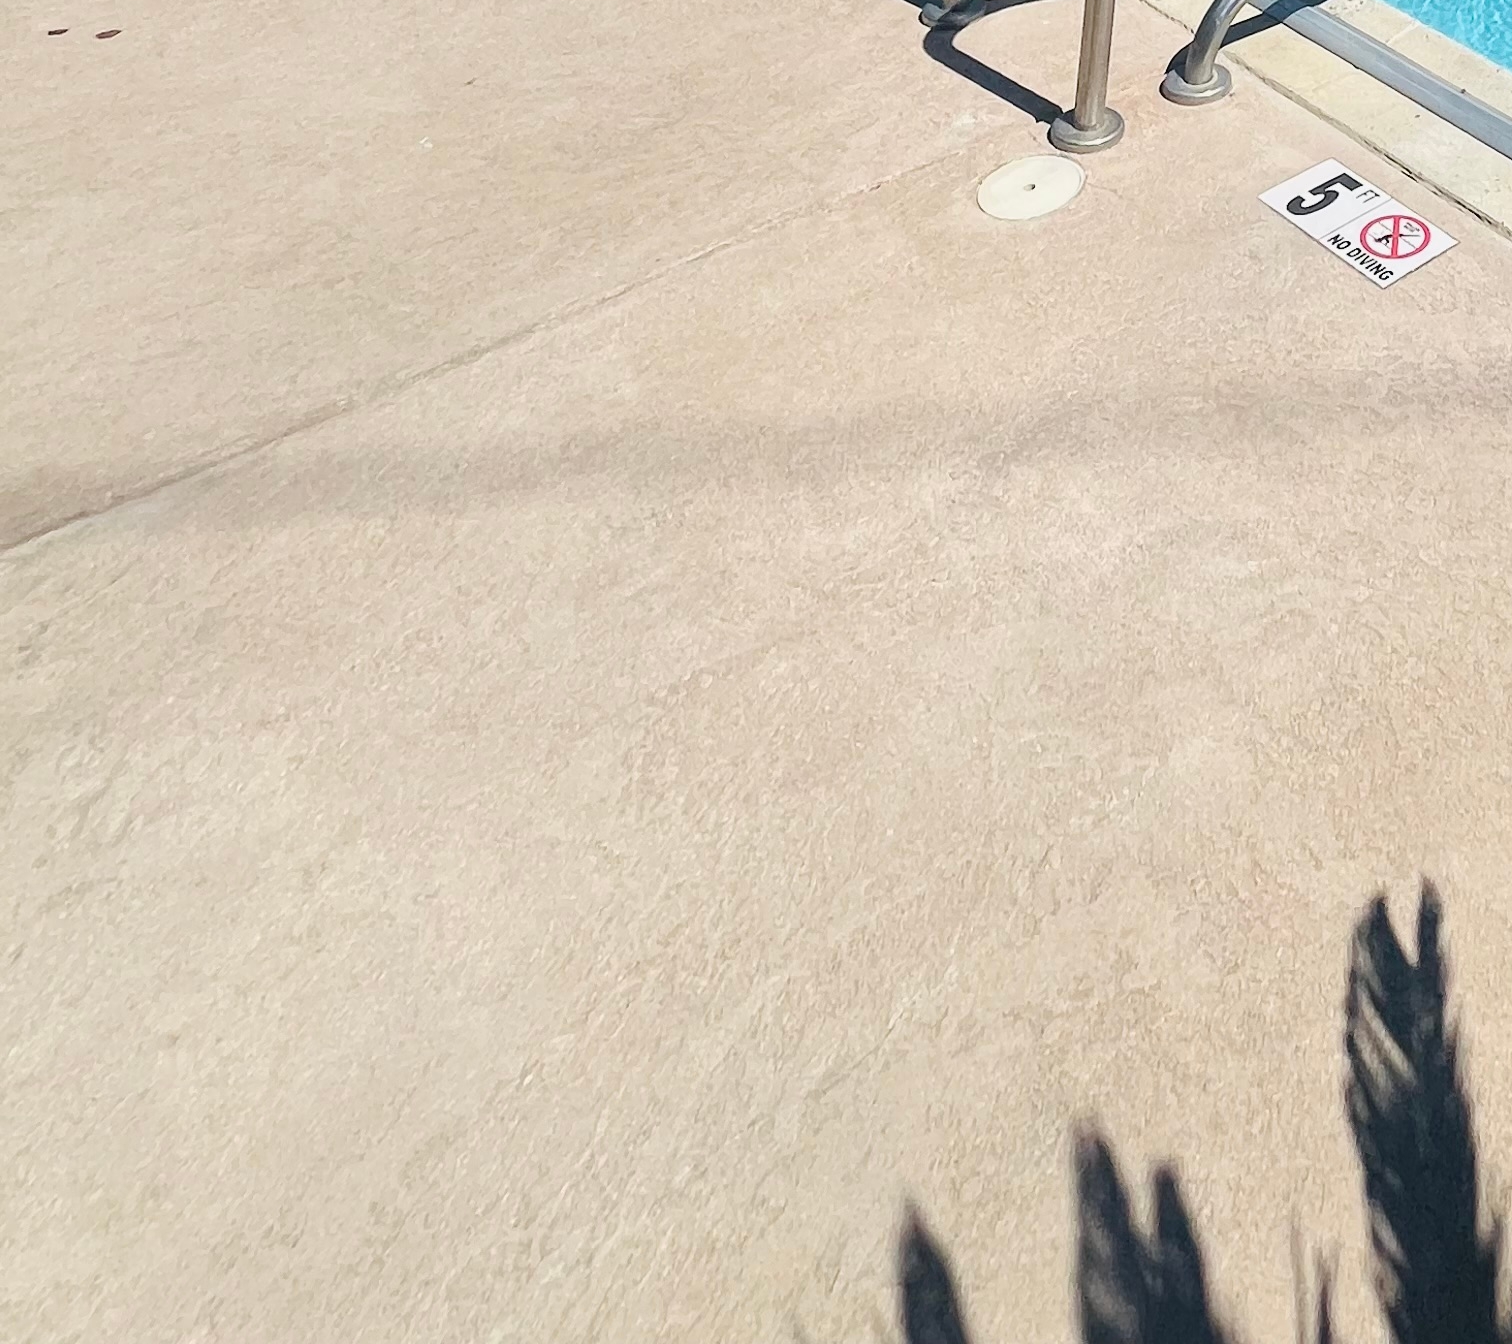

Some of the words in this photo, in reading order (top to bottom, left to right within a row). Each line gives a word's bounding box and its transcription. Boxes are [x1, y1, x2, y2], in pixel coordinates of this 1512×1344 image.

[1286, 172, 1364, 216] 5
[1355, 189, 1381, 204] FT
[1326, 234, 1351, 251] NO
[1346, 247, 1395, 282] DIVING
